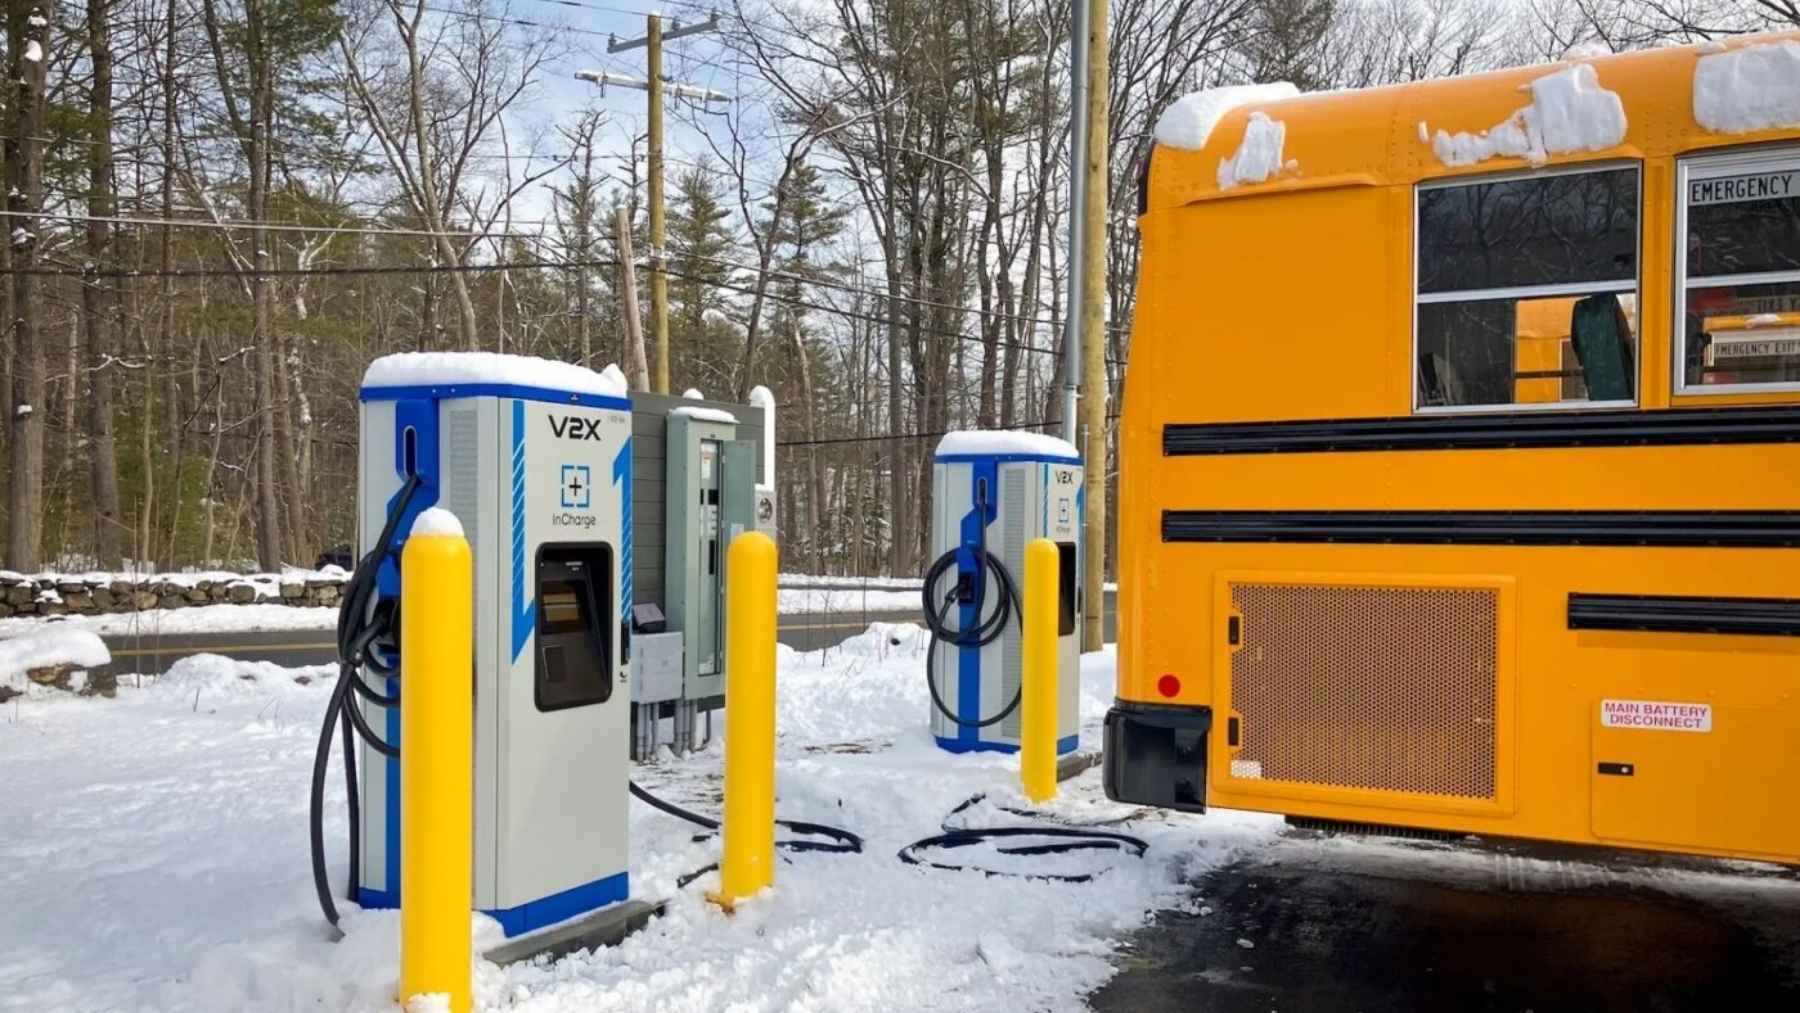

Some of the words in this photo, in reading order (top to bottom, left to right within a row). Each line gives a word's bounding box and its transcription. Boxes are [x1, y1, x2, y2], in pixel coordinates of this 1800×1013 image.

[1692, 174, 1792, 202] EMERGENCY
[548, 414, 601, 441] V2X
[1055, 470, 1073, 485] V2X
[552, 512, 597, 529] InCharge
[1605, 702, 1639, 713] MAIN
[1643, 704, 1707, 717] BATTERY
[1610, 714, 1703, 728] DISCONNECT
